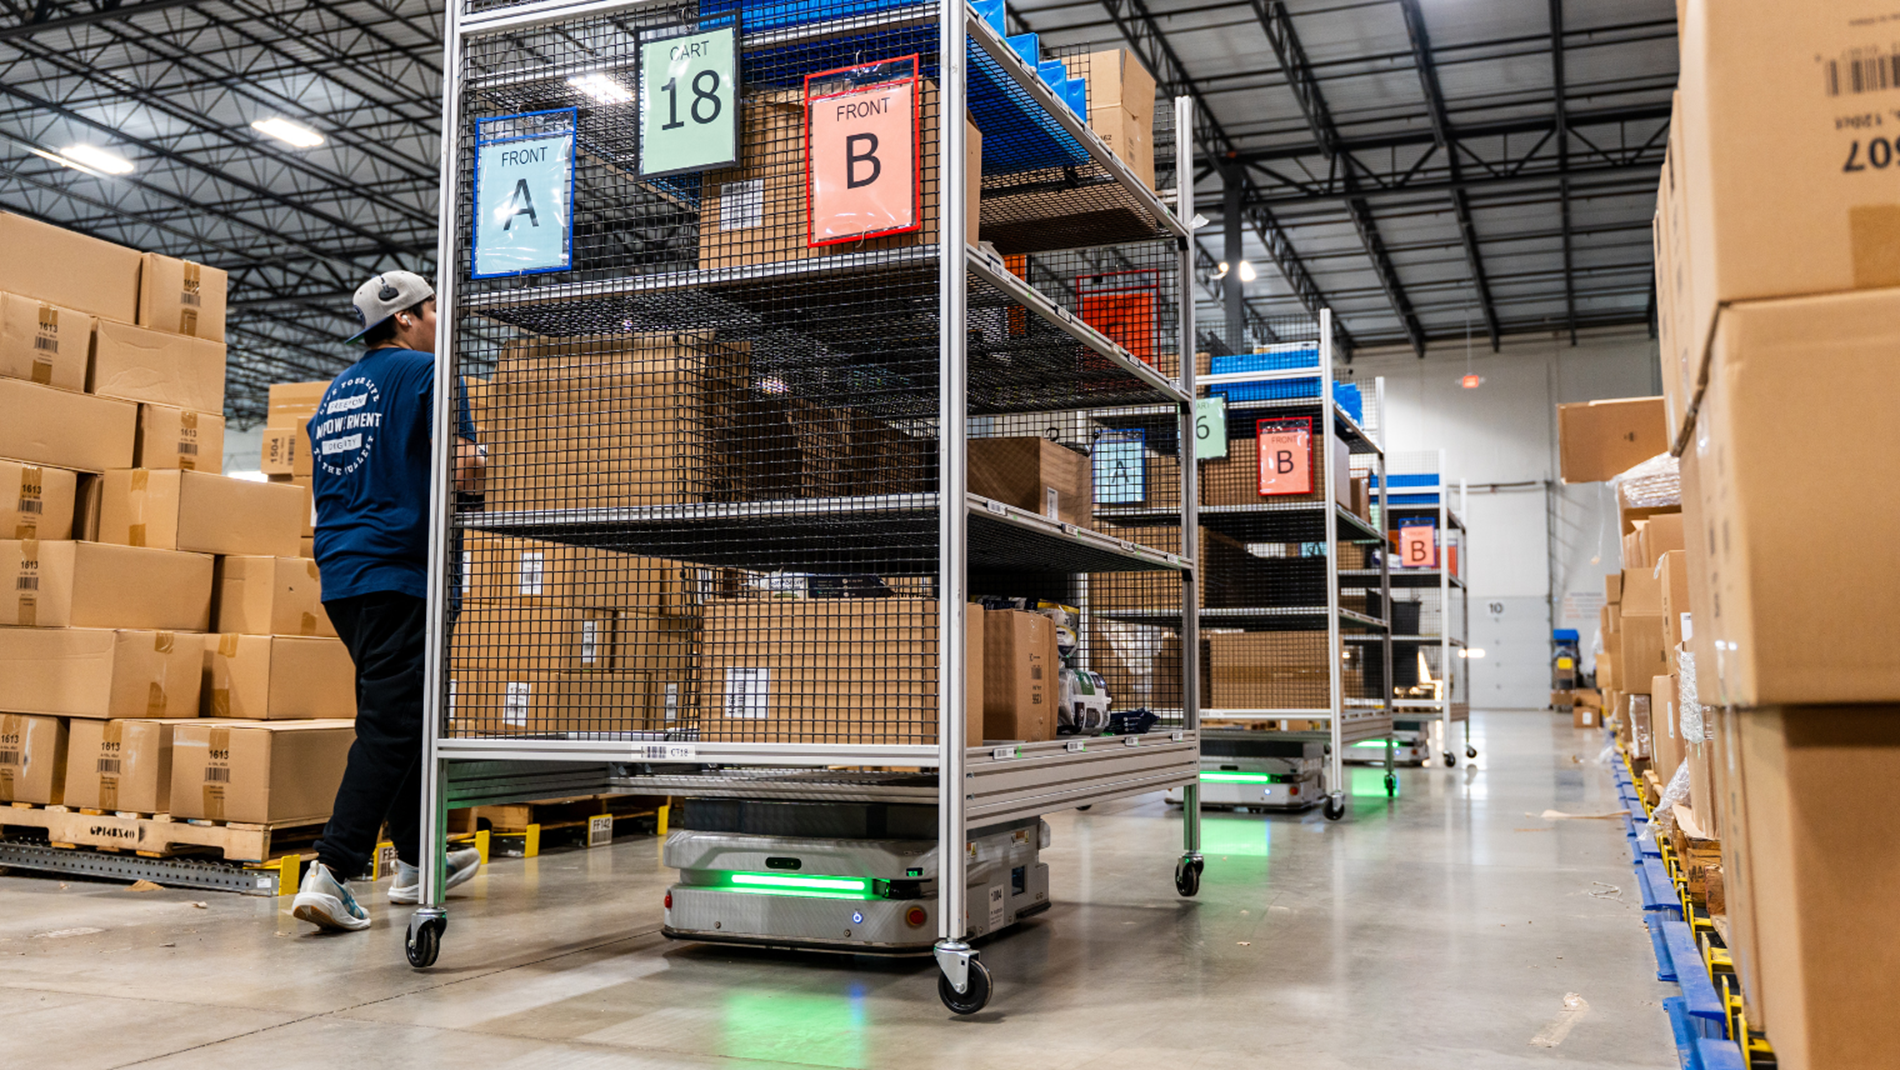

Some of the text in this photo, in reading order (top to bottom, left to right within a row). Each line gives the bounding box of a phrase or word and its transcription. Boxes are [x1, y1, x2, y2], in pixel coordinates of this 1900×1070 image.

[669, 40, 710, 61] CART
[661, 69, 722, 131] 18
[836, 97, 890, 122] FRONT
[501, 146, 548, 167] FRONT
[846, 132, 882, 190] B
[1842, 135, 1900, 174] 07
[503, 178, 539, 231] A
[39, 321, 58, 333] 1613
[180, 428, 197, 438] 1613
[1196, 415, 1210, 440] 6
[270, 437, 279, 463] 1504
[1271, 434, 1298, 445] FRONT
[1111, 460, 1130, 484] A
[1276, 449, 1295, 475] B
[22, 483, 42, 495] 1613
[1411, 540, 1427, 563] B
[21, 560, 38, 570] 1613
[1488, 601, 1504, 615] 10
[1, 734, 19, 744] 1613
[101, 741, 120, 752] 1613
[209, 749, 229, 760] 1613
[670, 747, 689, 757] CT18
[593, 818, 610, 830] FF142
